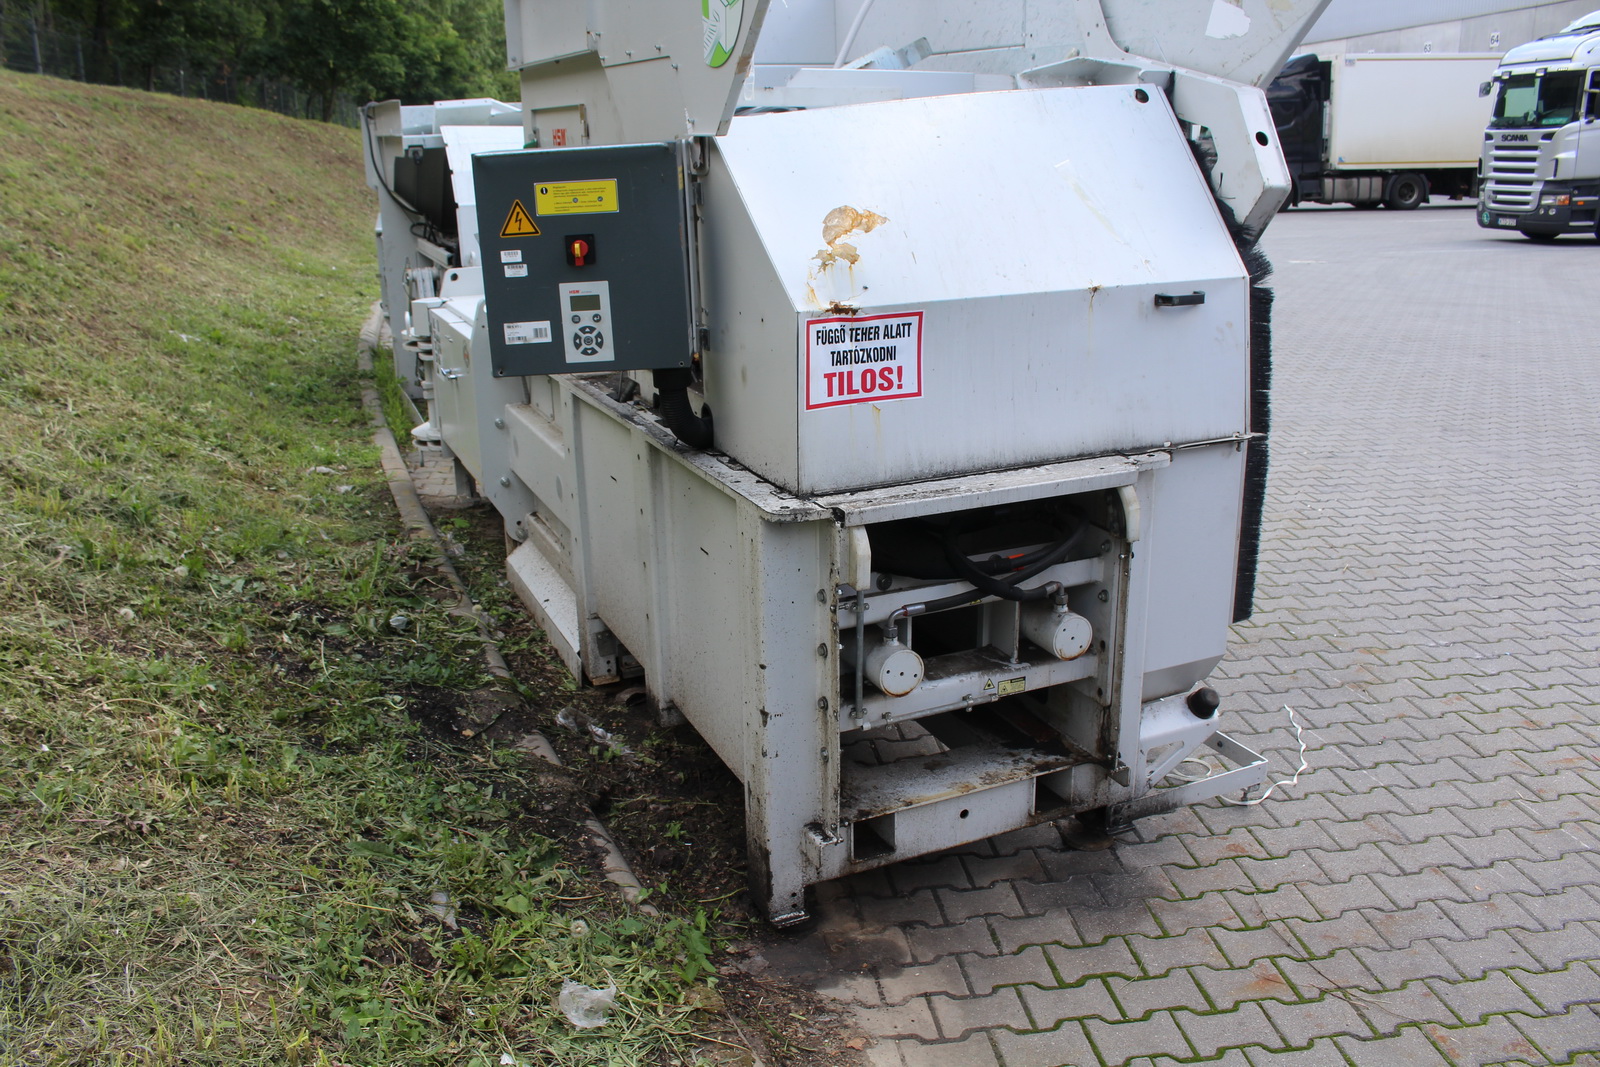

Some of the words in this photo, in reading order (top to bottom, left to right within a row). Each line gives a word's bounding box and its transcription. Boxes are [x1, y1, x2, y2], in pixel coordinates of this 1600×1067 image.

[1490, 35, 1499, 44] 64
[1424, 43, 1432, 53] 63
[1501, 134, 1528, 142] SCANIA
[816, 325, 846, 346] FÜGGŐ
[849, 325, 880, 343] TEHER
[882, 322, 913, 340] ALATT
[830, 345, 897, 367] TARTÓZKODNI
[823, 365, 903, 398] TILOS!
